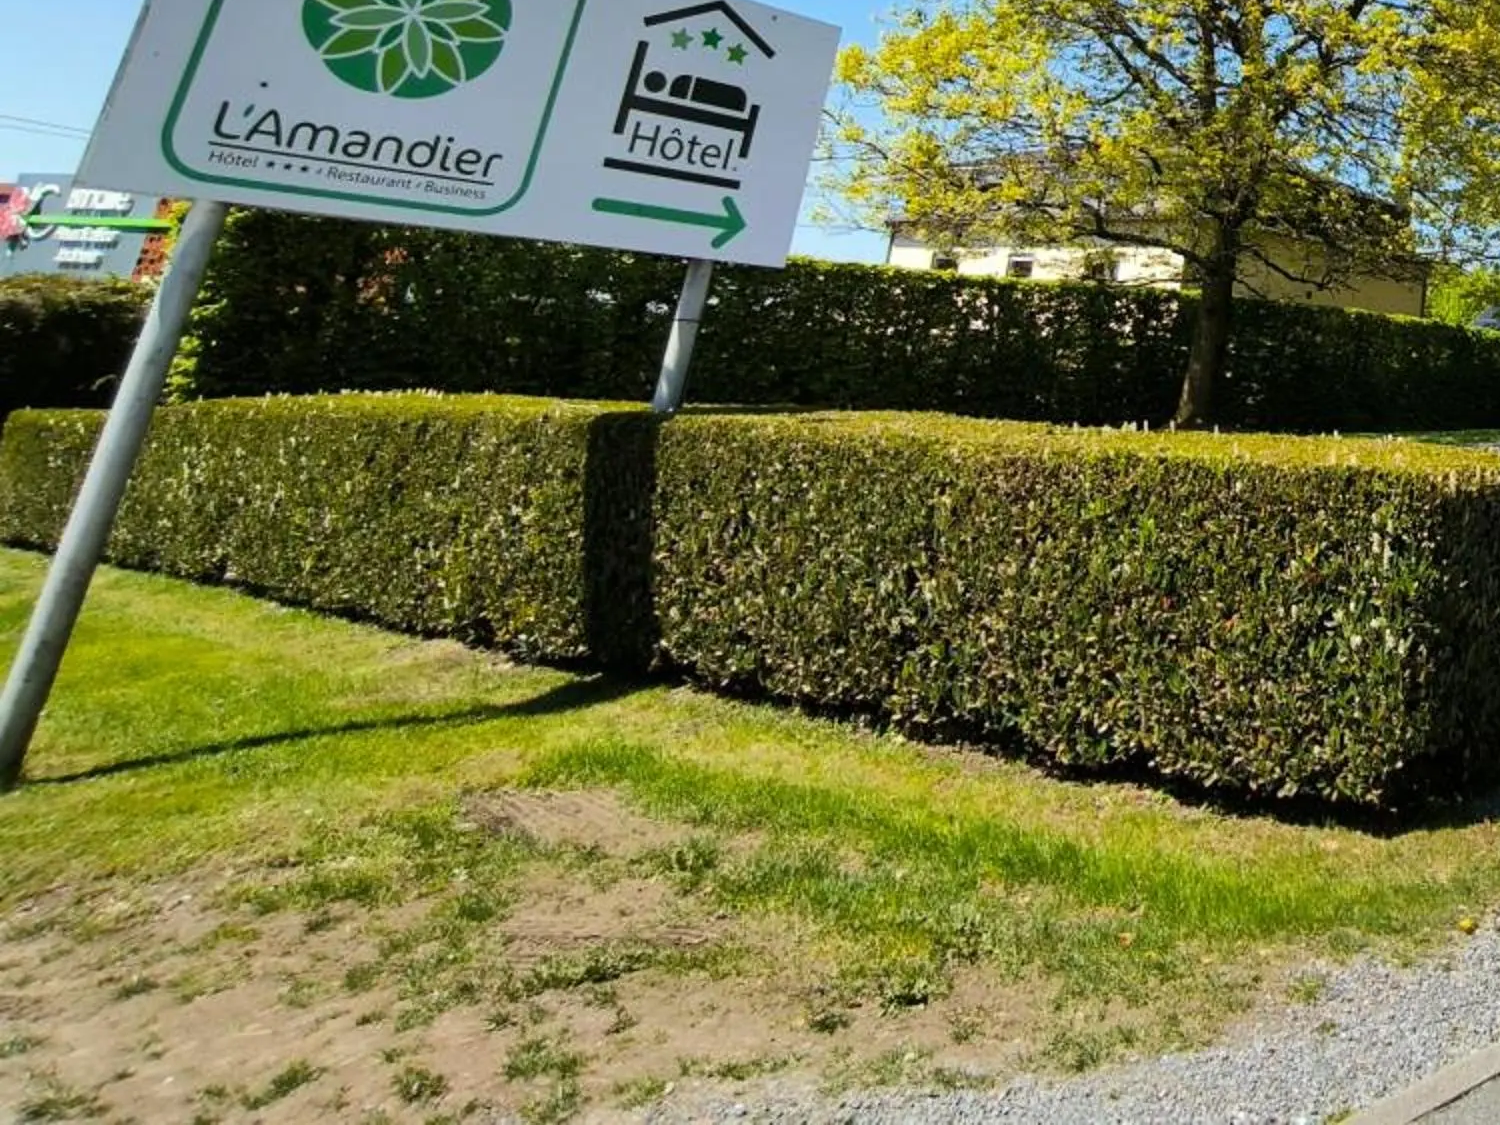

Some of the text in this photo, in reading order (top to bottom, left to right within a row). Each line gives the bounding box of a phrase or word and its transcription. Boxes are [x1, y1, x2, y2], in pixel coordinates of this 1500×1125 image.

[213, 101, 503, 177] L'Amandier
[628, 121, 734, 171] Hôtel
[326, 166, 412, 190] Restaurant
[423, 180, 487, 200] Business
